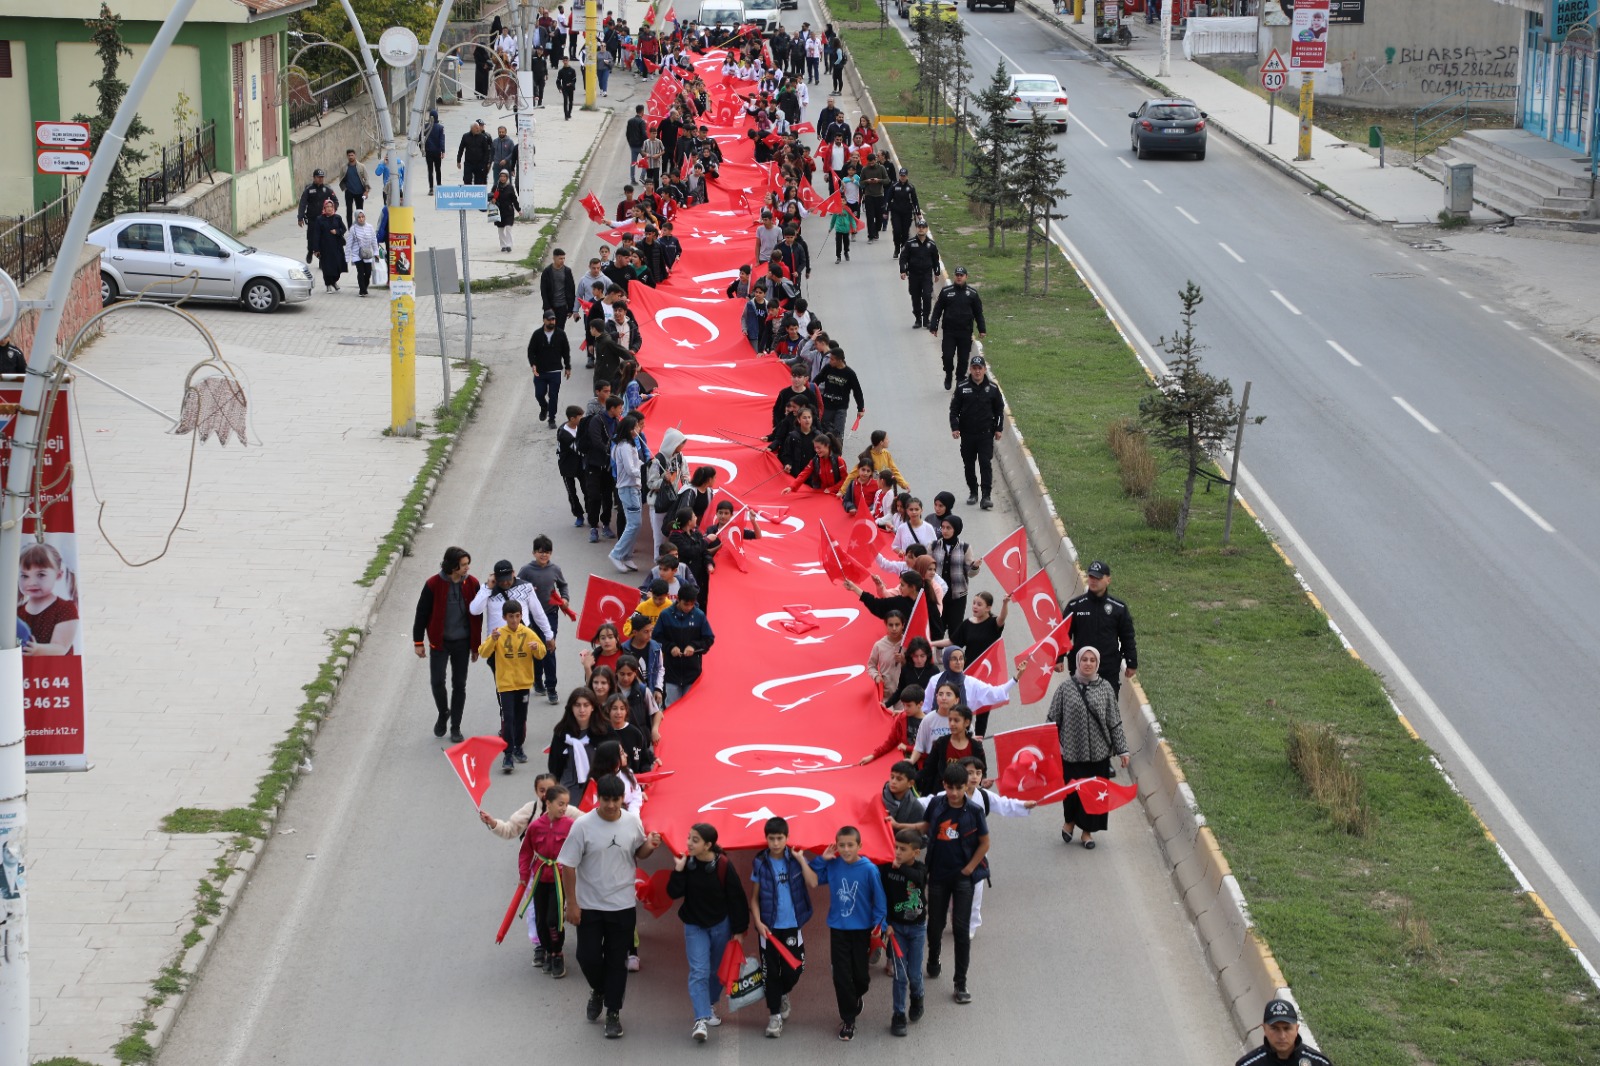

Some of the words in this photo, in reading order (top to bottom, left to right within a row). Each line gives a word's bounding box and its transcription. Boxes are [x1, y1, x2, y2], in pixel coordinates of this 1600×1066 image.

[1557, 0, 1590, 13] HARCA
[1427, 46, 1478, 62] ARSA
[1266, 74, 1281, 86] 30
[33, 677, 50, 689] 16
[52, 676, 70, 689] 44
[33, 697, 51, 709] 46
[53, 696, 71, 709] 25
